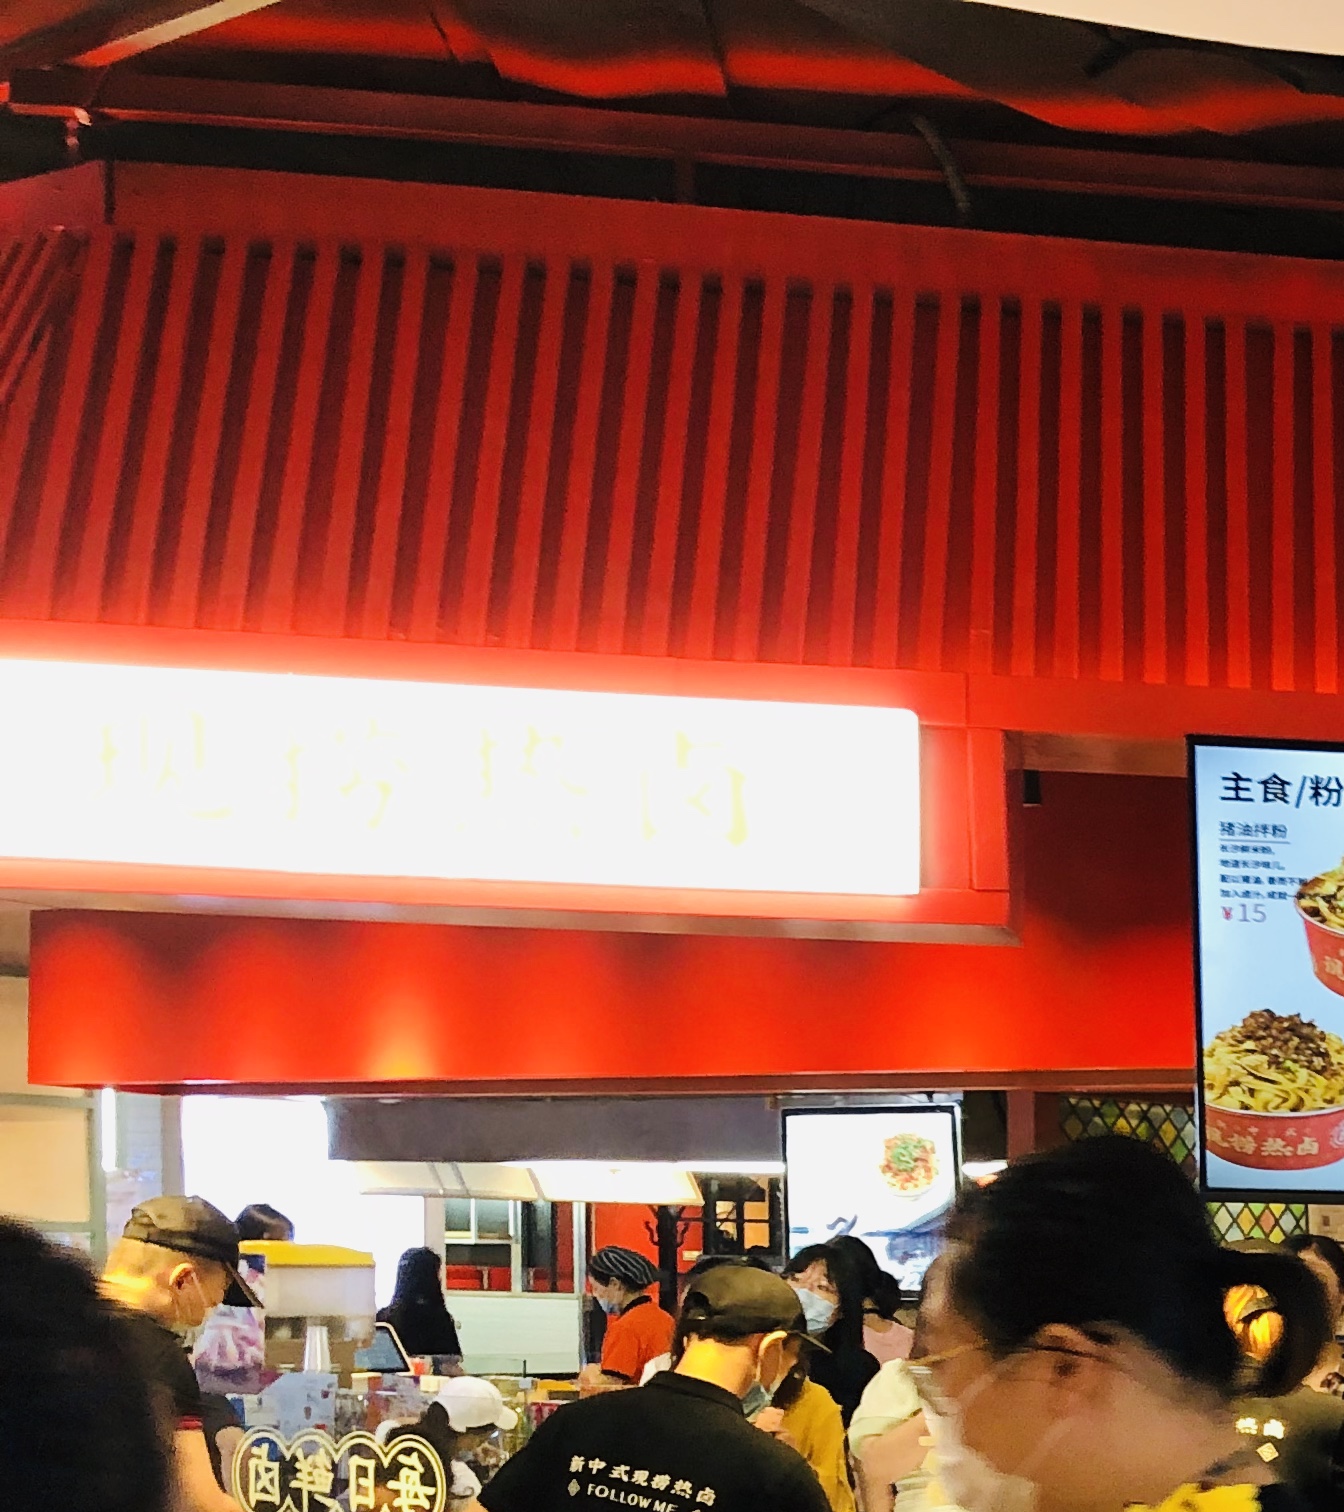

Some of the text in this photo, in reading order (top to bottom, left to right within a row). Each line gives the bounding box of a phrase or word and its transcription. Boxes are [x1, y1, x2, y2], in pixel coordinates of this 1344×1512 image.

[1219, 820, 1288, 838] 猪油拌粉
[587, 1483, 652, 1509] FOLLOW
